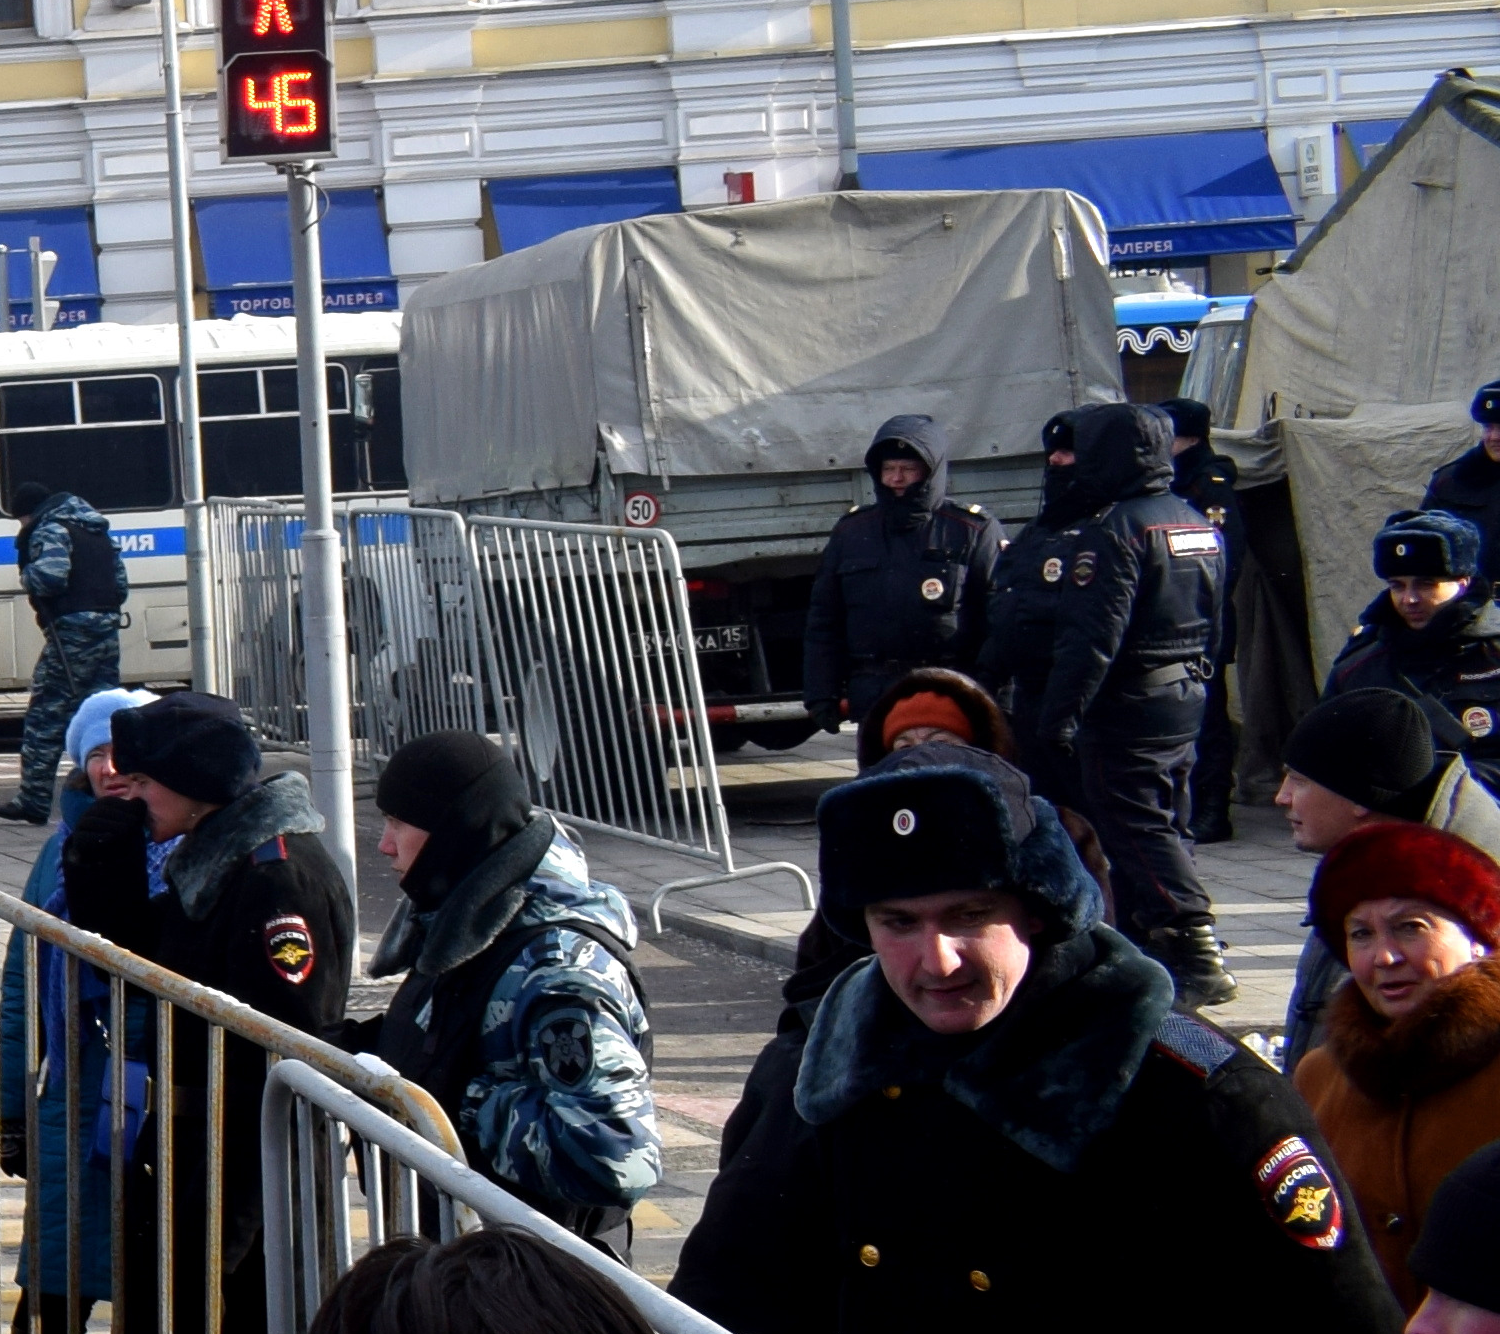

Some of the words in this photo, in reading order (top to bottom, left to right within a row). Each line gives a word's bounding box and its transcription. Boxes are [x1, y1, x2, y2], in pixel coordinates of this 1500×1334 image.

[245, 71, 317, 134] 45
[321, 292, 384, 307] АЛЕРЕЯ
[722, 627, 741, 643] 15
[1258, 1140, 1304, 1182] ПОЛИЦИЯ
[1274, 1165, 1318, 1204] РОССИЯ
